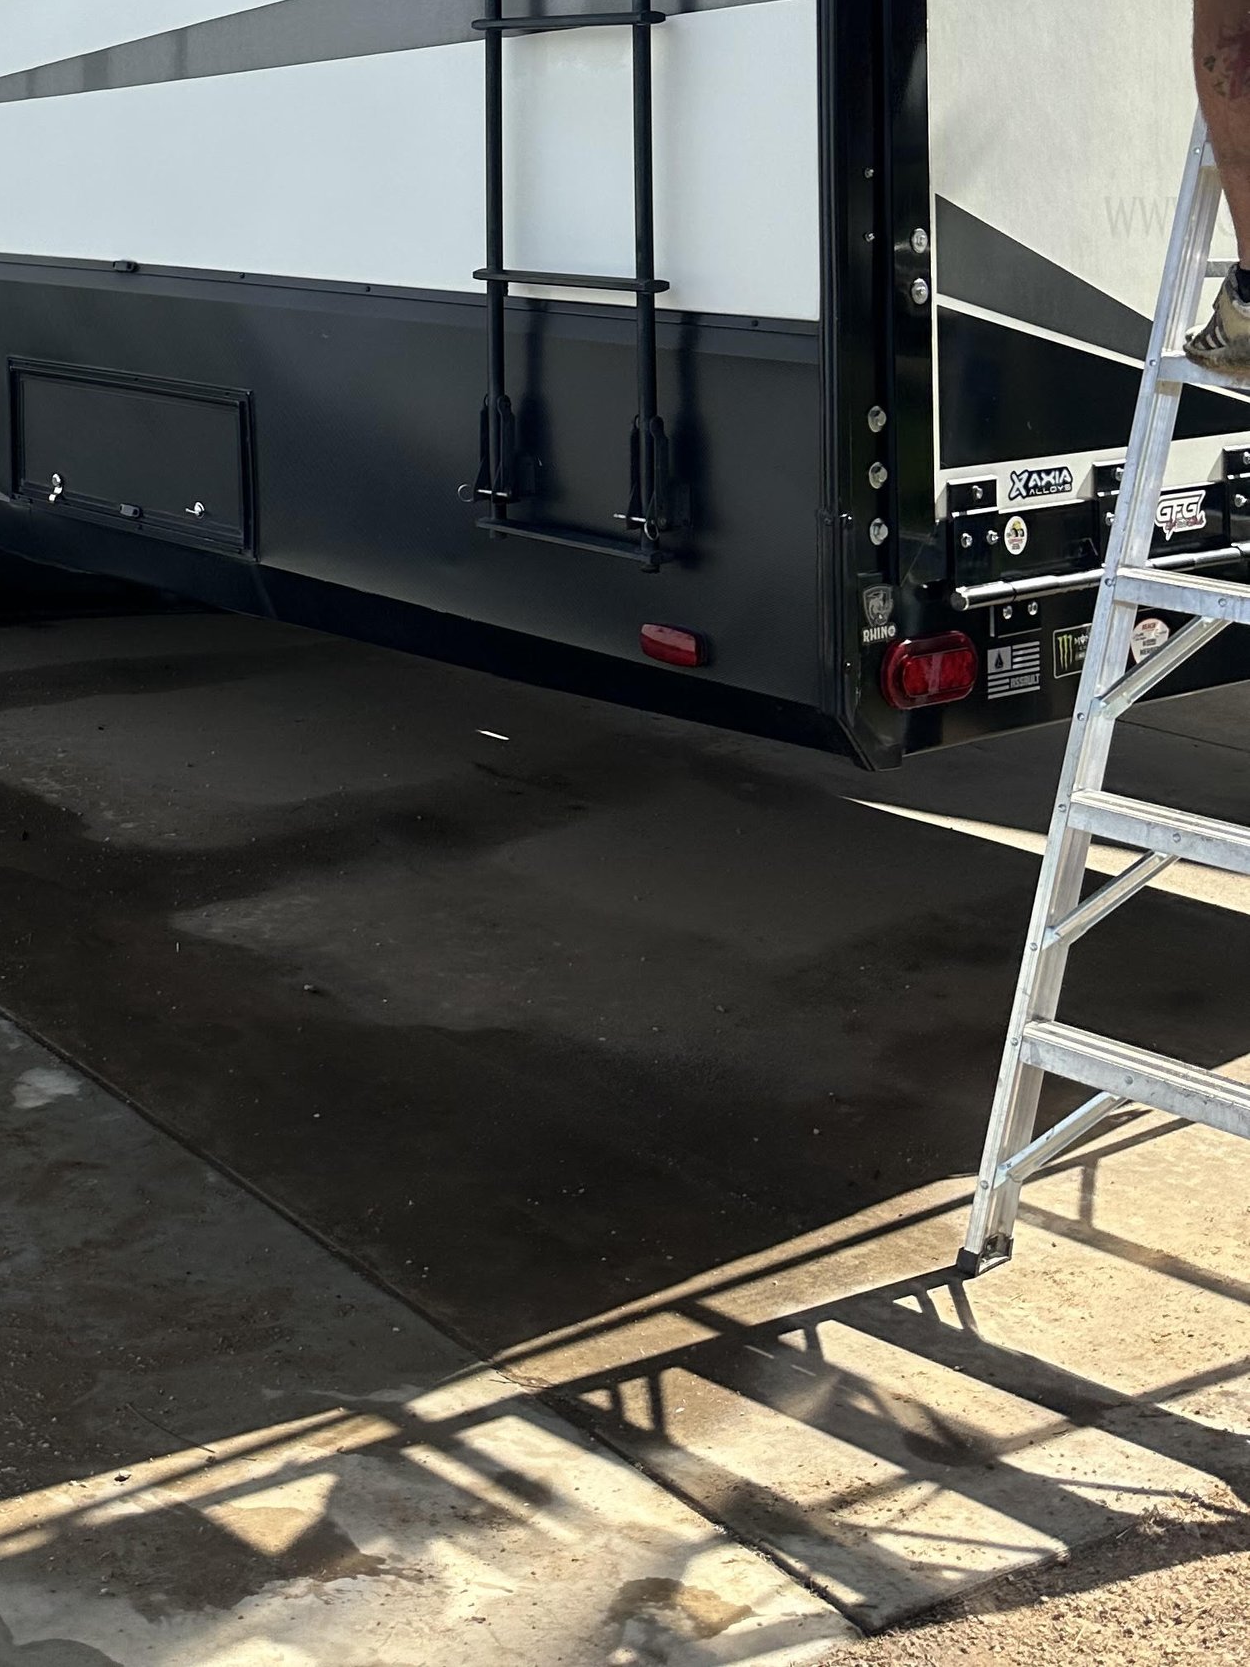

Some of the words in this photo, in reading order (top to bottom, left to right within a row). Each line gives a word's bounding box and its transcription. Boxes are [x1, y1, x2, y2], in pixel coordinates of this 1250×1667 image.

[1028, 468, 1072, 488] AXIA
[1029, 483, 1072, 496] ALLOYS
[862, 624, 897, 645] RHINO
